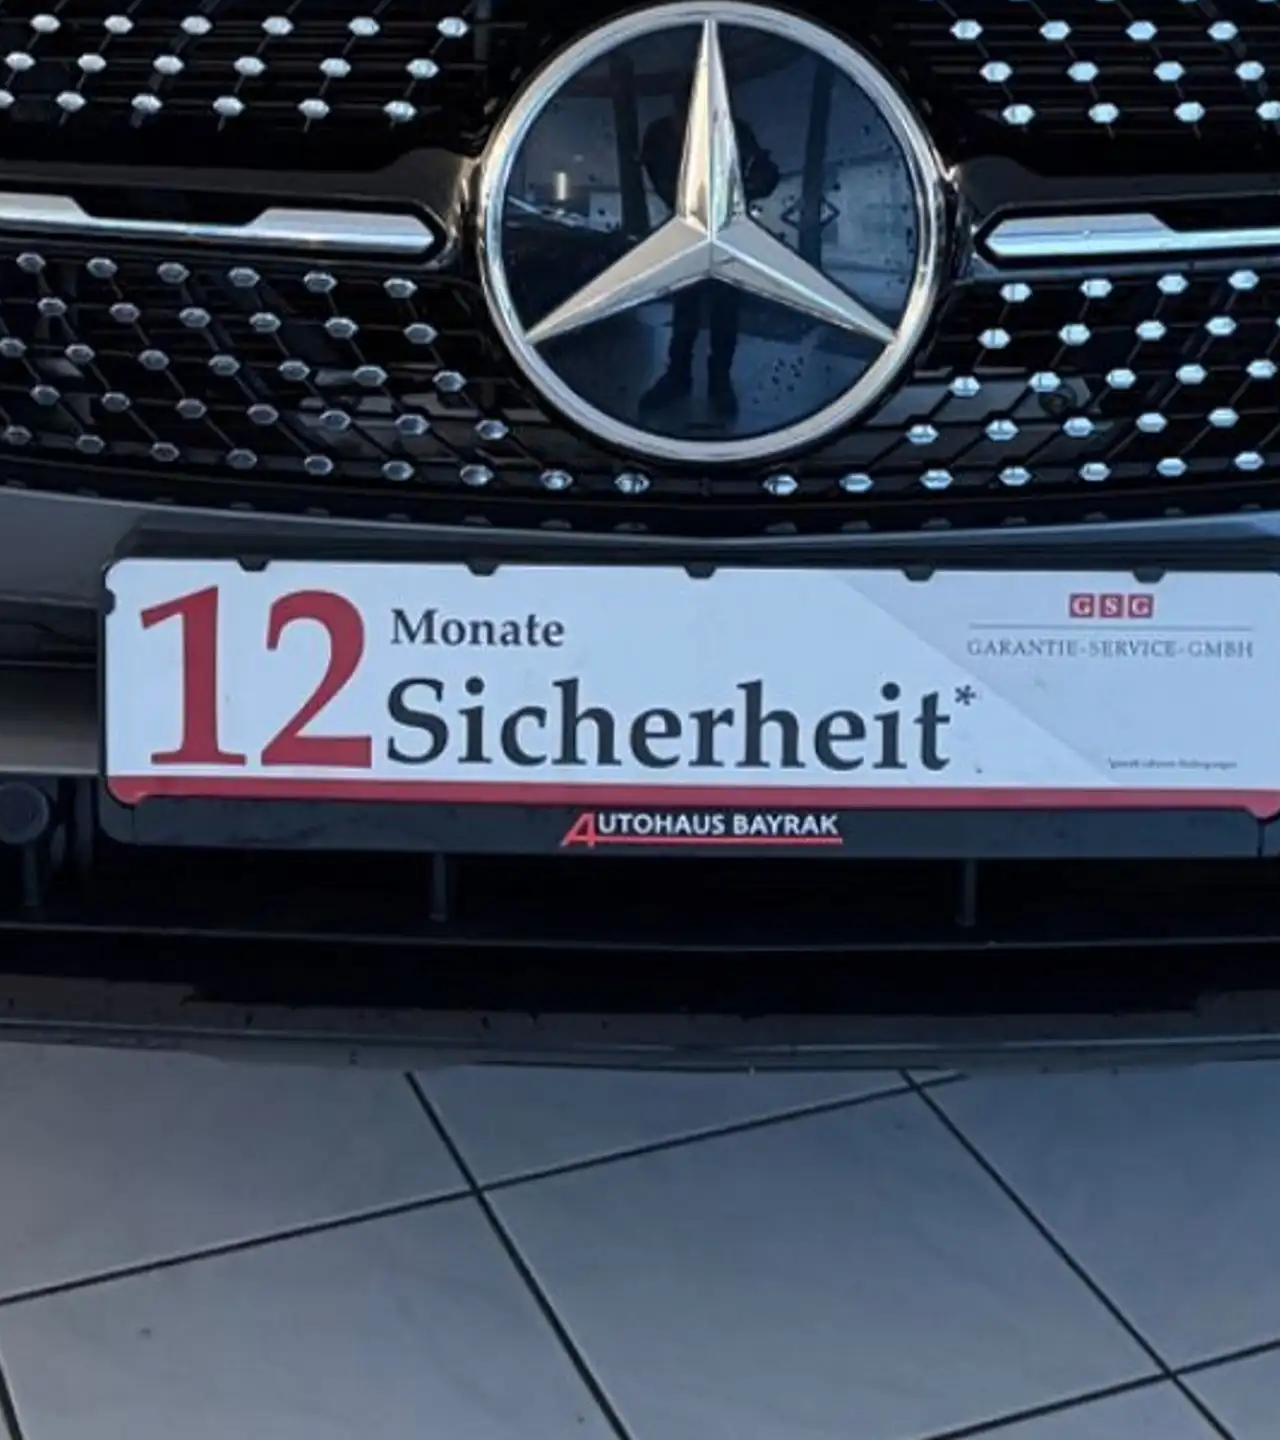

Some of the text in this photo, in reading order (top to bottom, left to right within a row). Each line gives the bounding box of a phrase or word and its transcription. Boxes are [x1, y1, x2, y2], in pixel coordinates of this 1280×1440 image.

[1070, 594, 1153, 618] GSG
[391, 608, 565, 647] Monate
[140, 585, 372, 769] 12
[561, 812, 838, 847] AUTOHAUS BAYRAK
